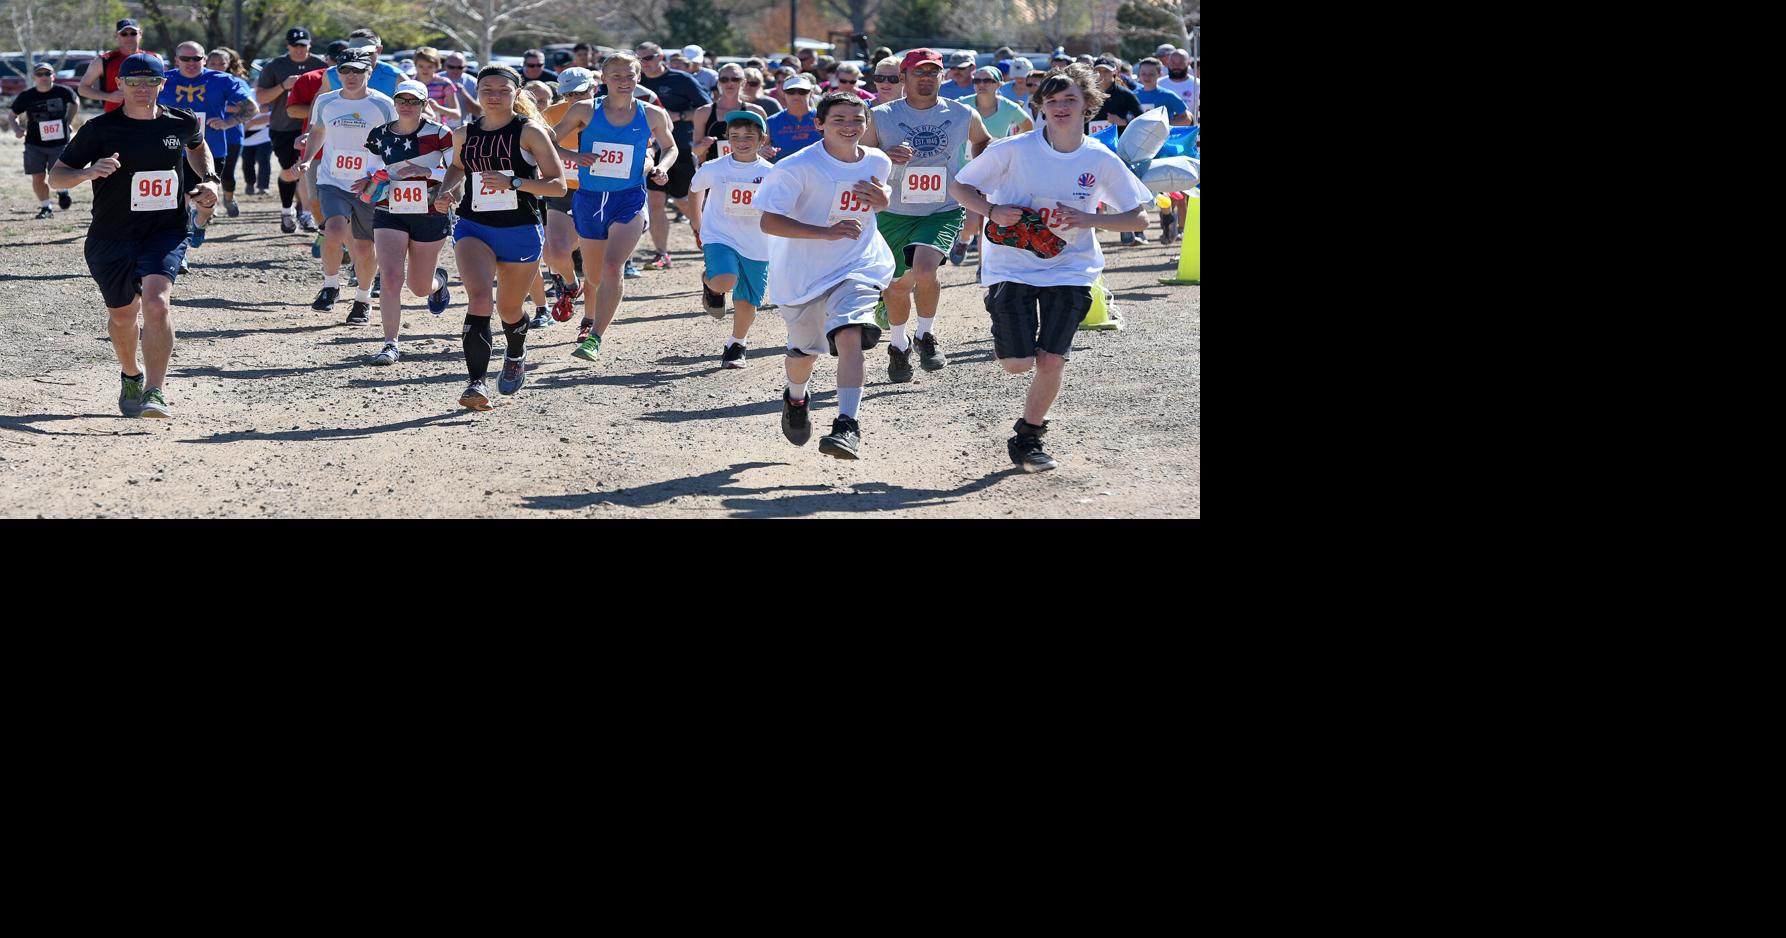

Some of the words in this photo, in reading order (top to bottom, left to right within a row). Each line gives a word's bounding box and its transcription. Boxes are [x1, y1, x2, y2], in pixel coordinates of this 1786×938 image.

[43, 123, 60, 134] 867
[465, 134, 513, 159] RUN
[336, 155, 363, 170] 869
[599, 149, 624, 164] 263
[138, 178, 172, 197] 961
[908, 174, 941, 191] 980
[393, 187, 422, 202] 848
[731, 186, 756, 205] 98
